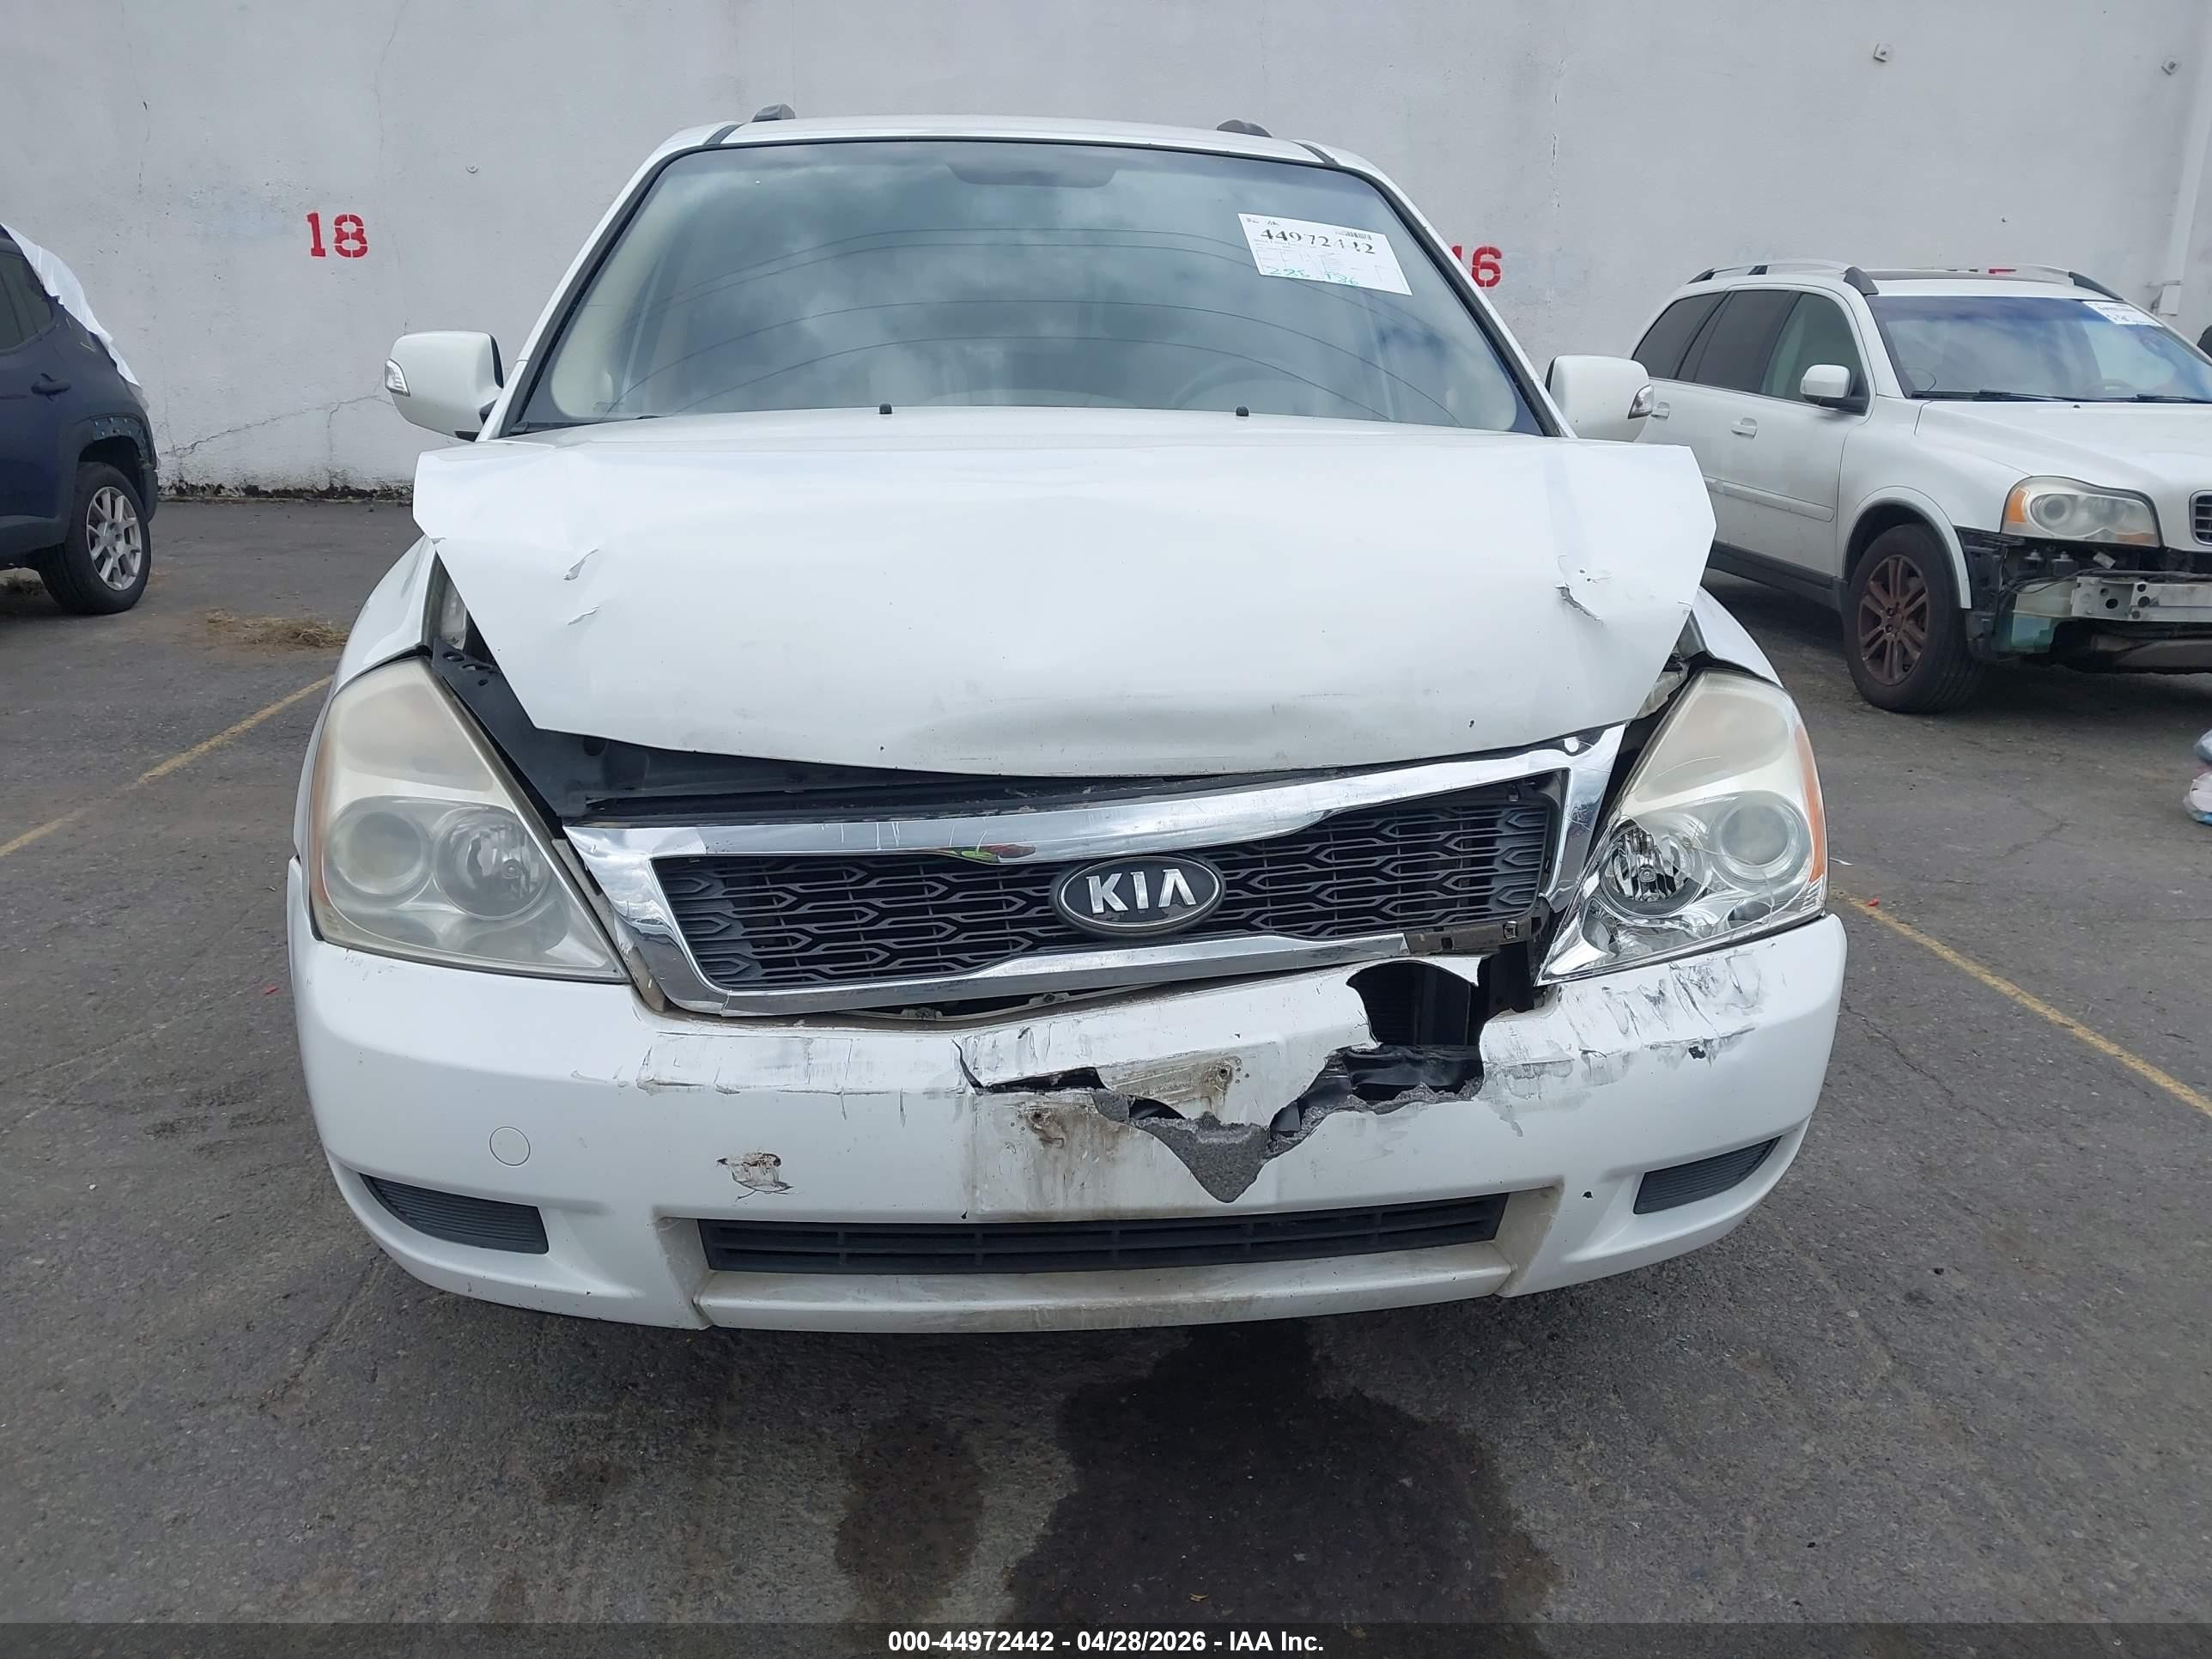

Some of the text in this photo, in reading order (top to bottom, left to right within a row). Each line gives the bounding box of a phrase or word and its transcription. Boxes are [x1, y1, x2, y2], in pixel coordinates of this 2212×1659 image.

[307, 212, 368, 258] 18
[1451, 245, 1503, 288] 6
[1085, 868, 1196, 914] KIA
